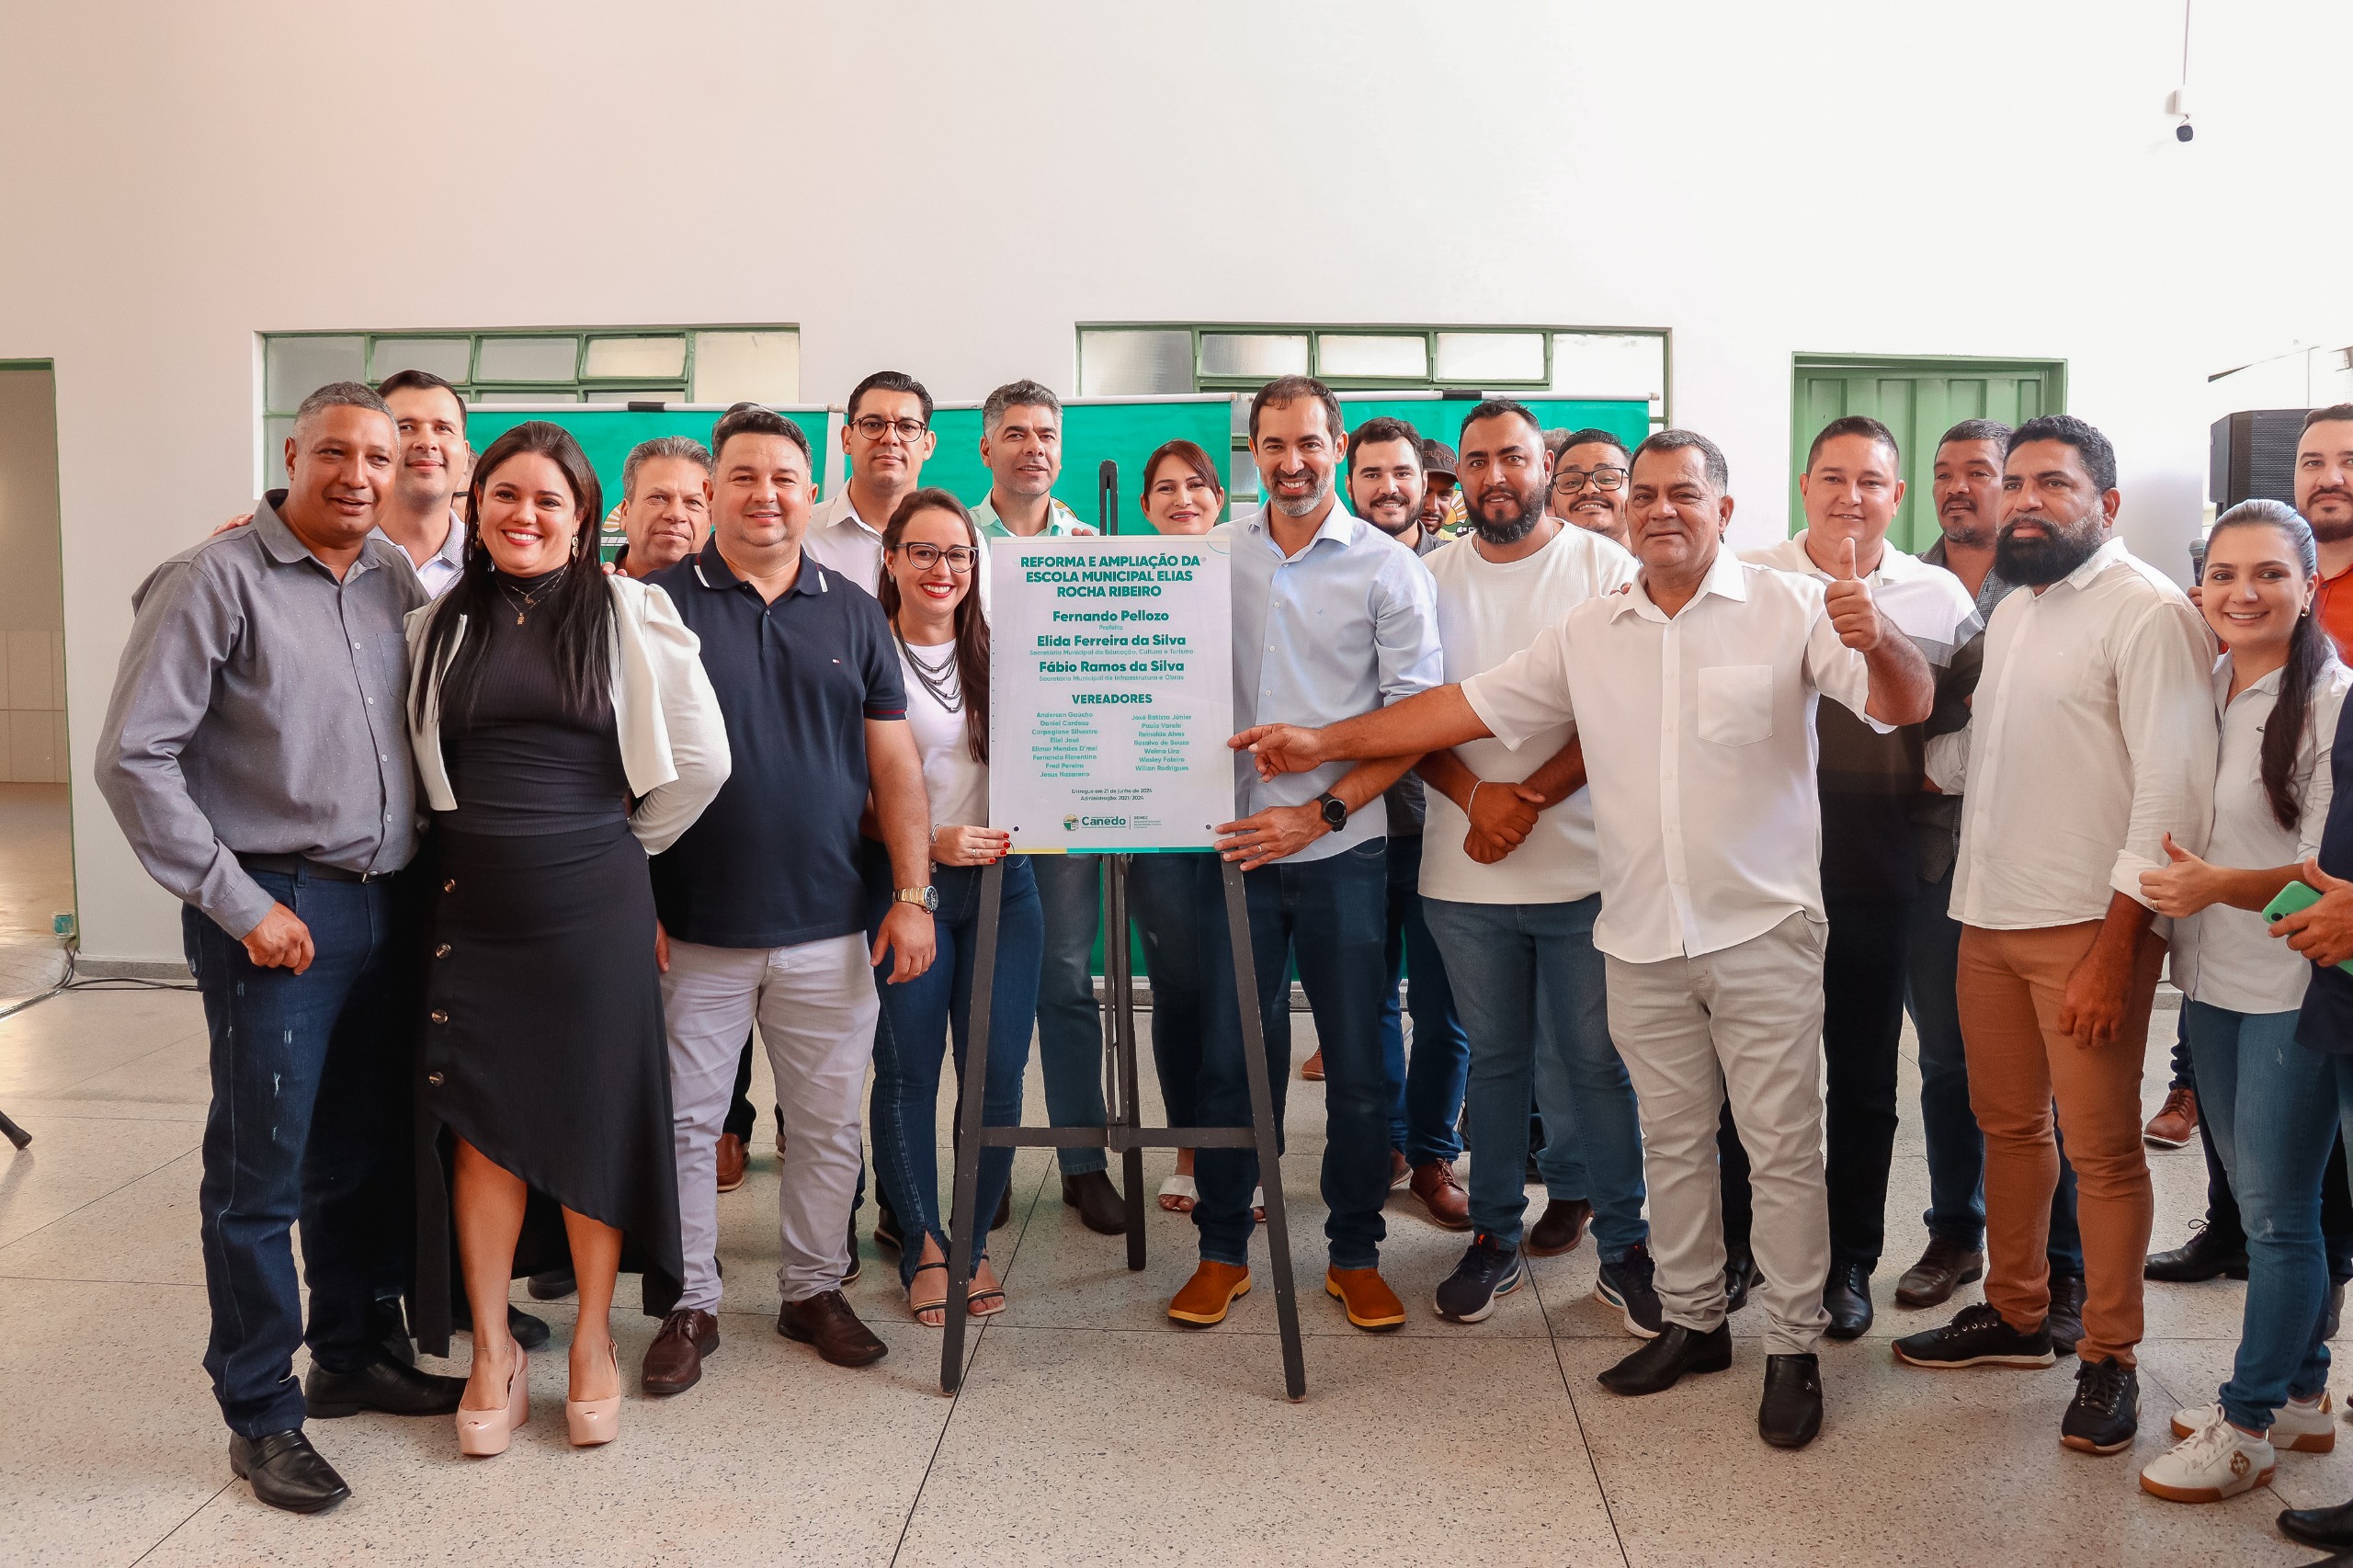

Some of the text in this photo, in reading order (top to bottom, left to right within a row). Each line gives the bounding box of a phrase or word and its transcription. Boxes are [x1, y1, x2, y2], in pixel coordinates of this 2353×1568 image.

[1021, 553, 1200, 569] REFORMA E AMPLIAÇÃO DA
[1027, 571, 1192, 583] ESCOLA MUNICIPAL ELIAS
[1057, 586, 1161, 597] ROCHA RIBEIRO
[1053, 610, 1169, 621] Fernando Pellozo
[1038, 634, 1186, 646] Elida Ferreira da Silva
[1040, 660, 1184, 672] Fábio Ramos da Silva
[1072, 694, 1152, 704] VEREADORES
[1082, 816, 1126, 825] Canedo
